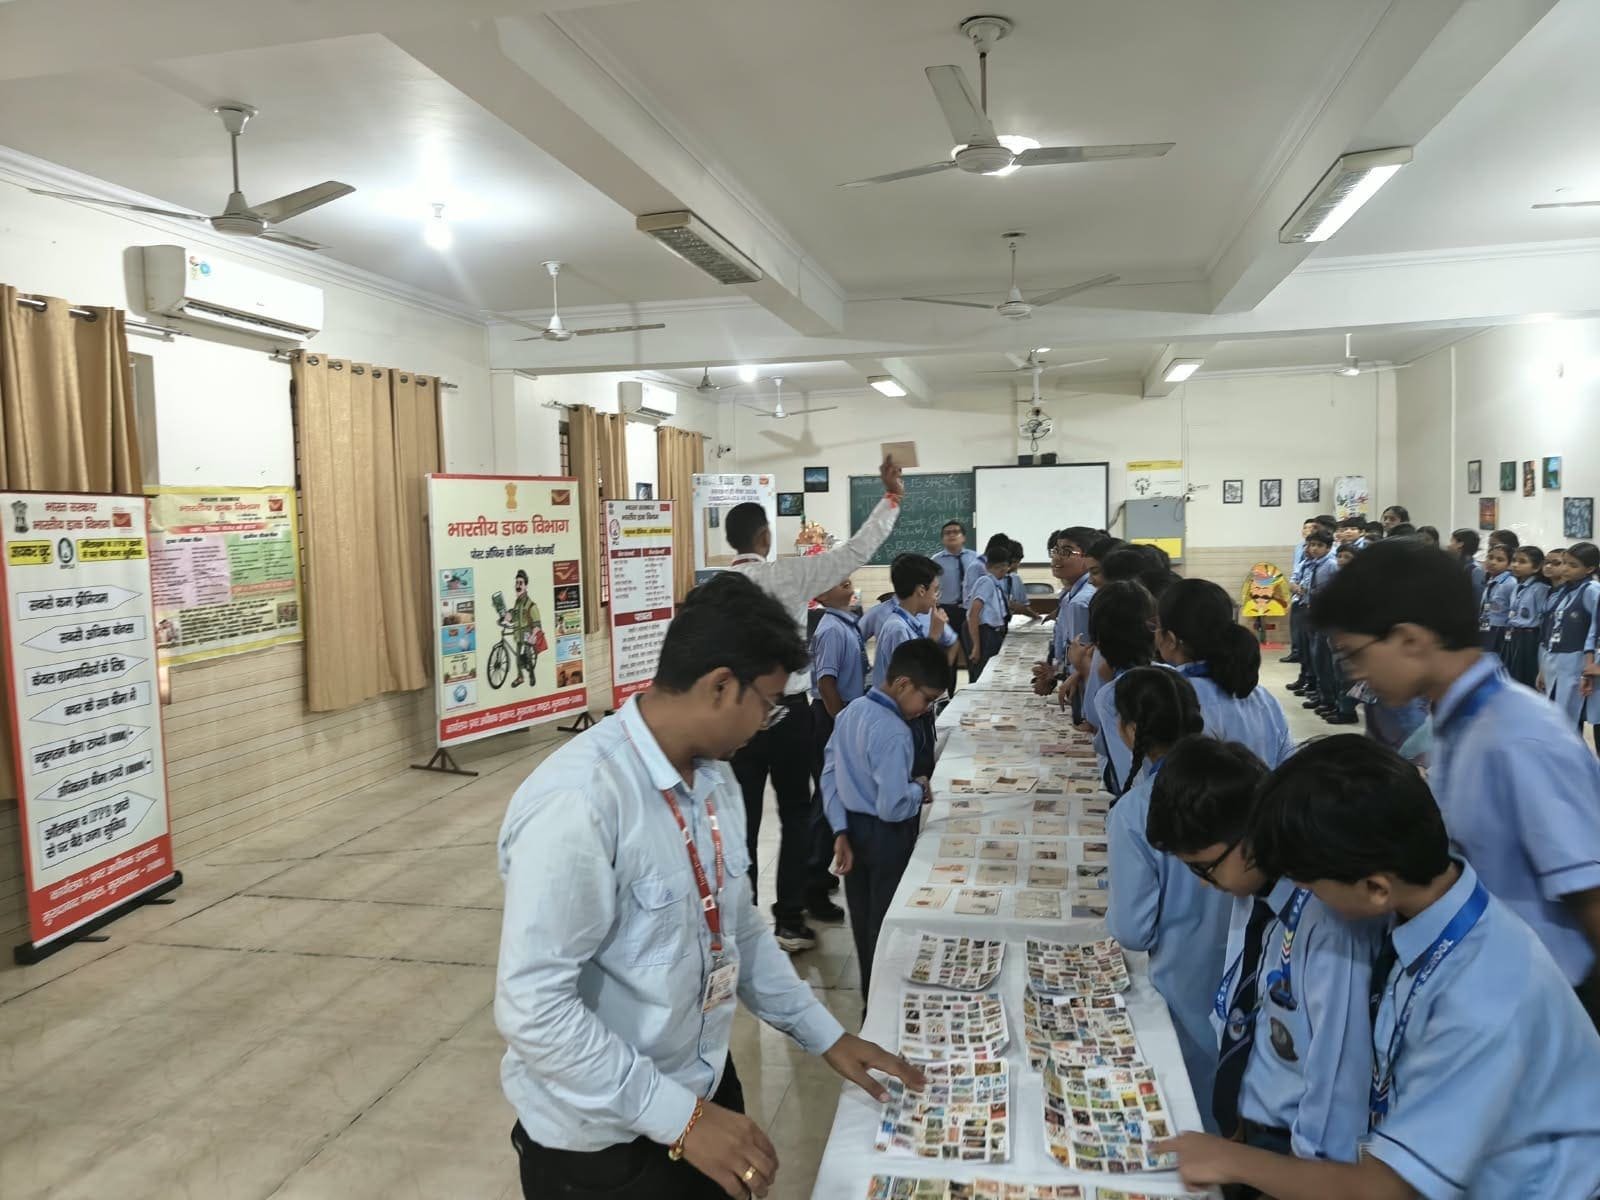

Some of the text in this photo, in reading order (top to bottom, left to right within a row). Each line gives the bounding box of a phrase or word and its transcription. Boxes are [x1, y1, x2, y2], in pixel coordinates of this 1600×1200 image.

[448, 514, 569, 537] भारतीय डाक विभाग
